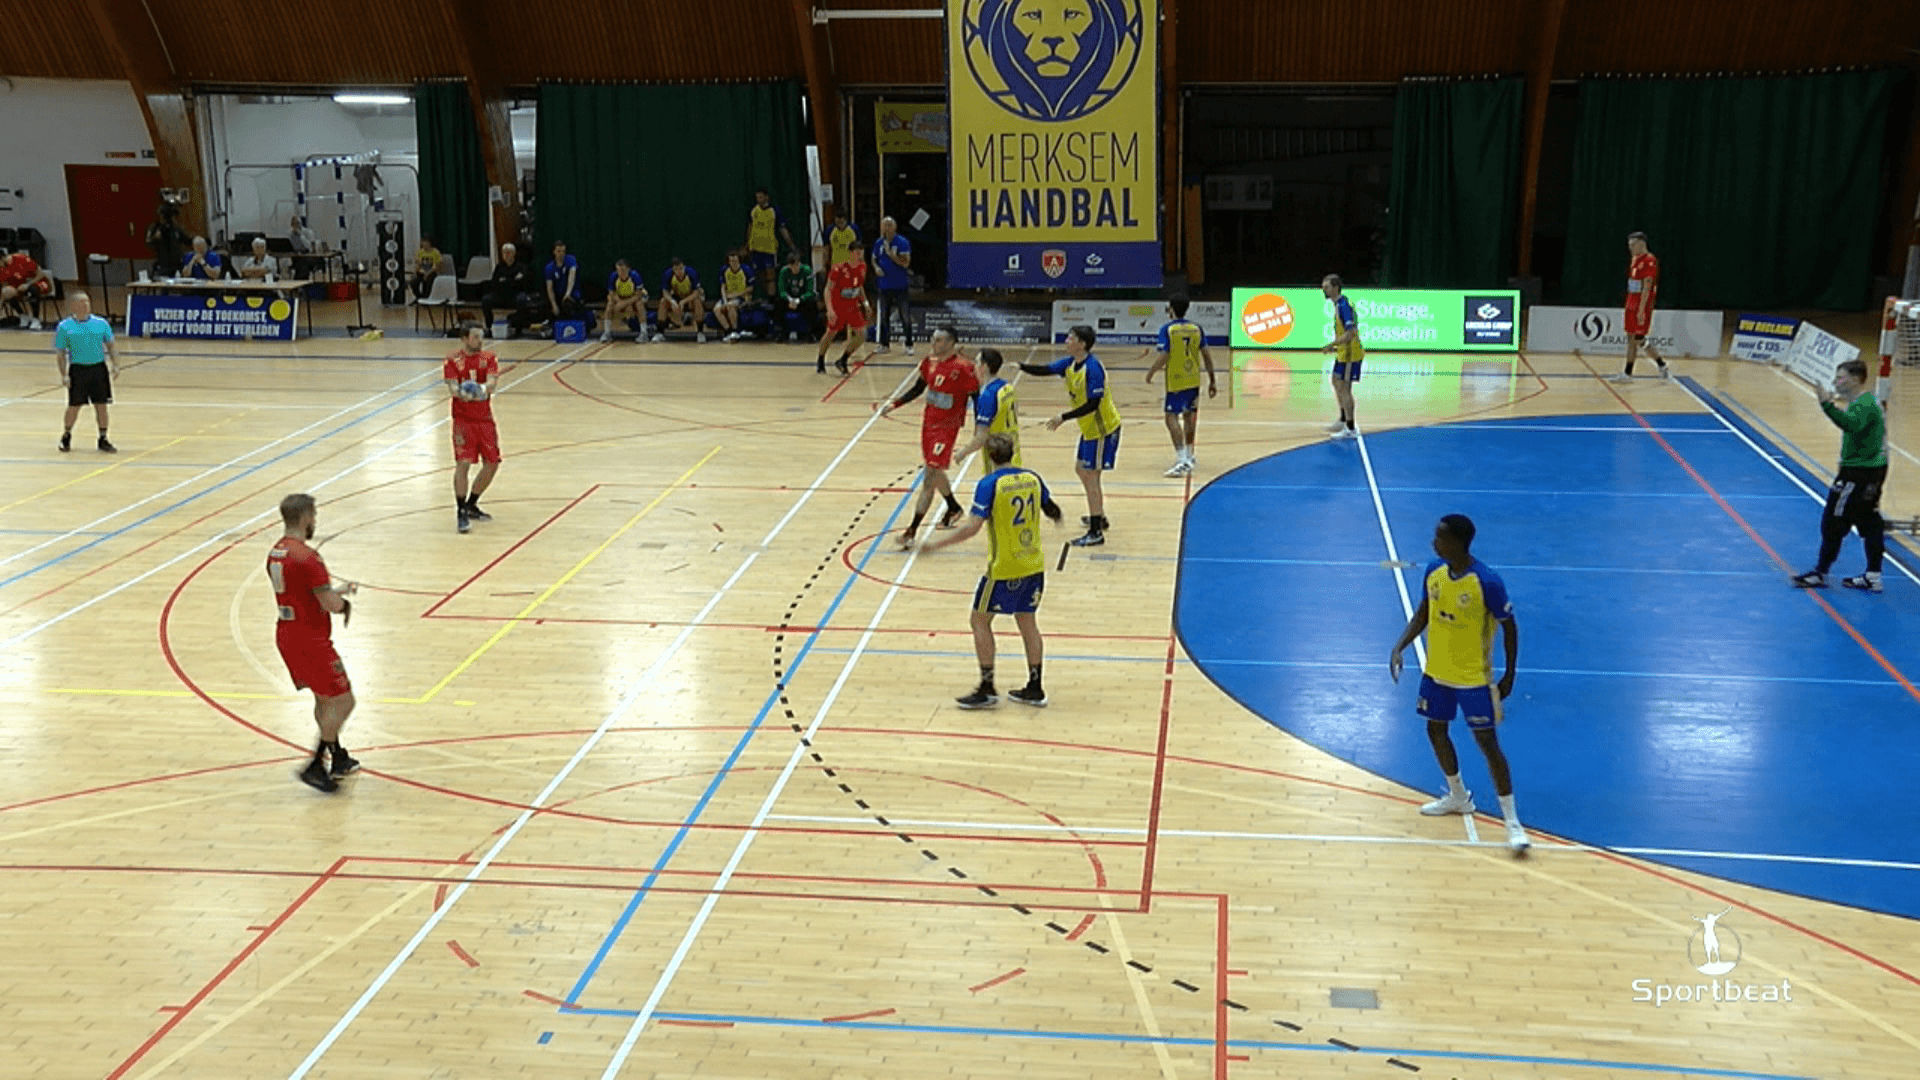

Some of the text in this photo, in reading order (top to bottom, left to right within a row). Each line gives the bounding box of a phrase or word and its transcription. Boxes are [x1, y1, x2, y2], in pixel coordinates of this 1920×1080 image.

[968, 131, 1138, 183] MERKSEM
[969, 187, 1139, 229] HANDBAL
[143, 321, 280, 336] RESPECT VOOR HET VERLEDEN
[154, 308, 267, 323] VIZIER OP DE TOEKOMST,
[1181, 336, 1191, 357] 7
[1011, 492, 1035, 527] 21
